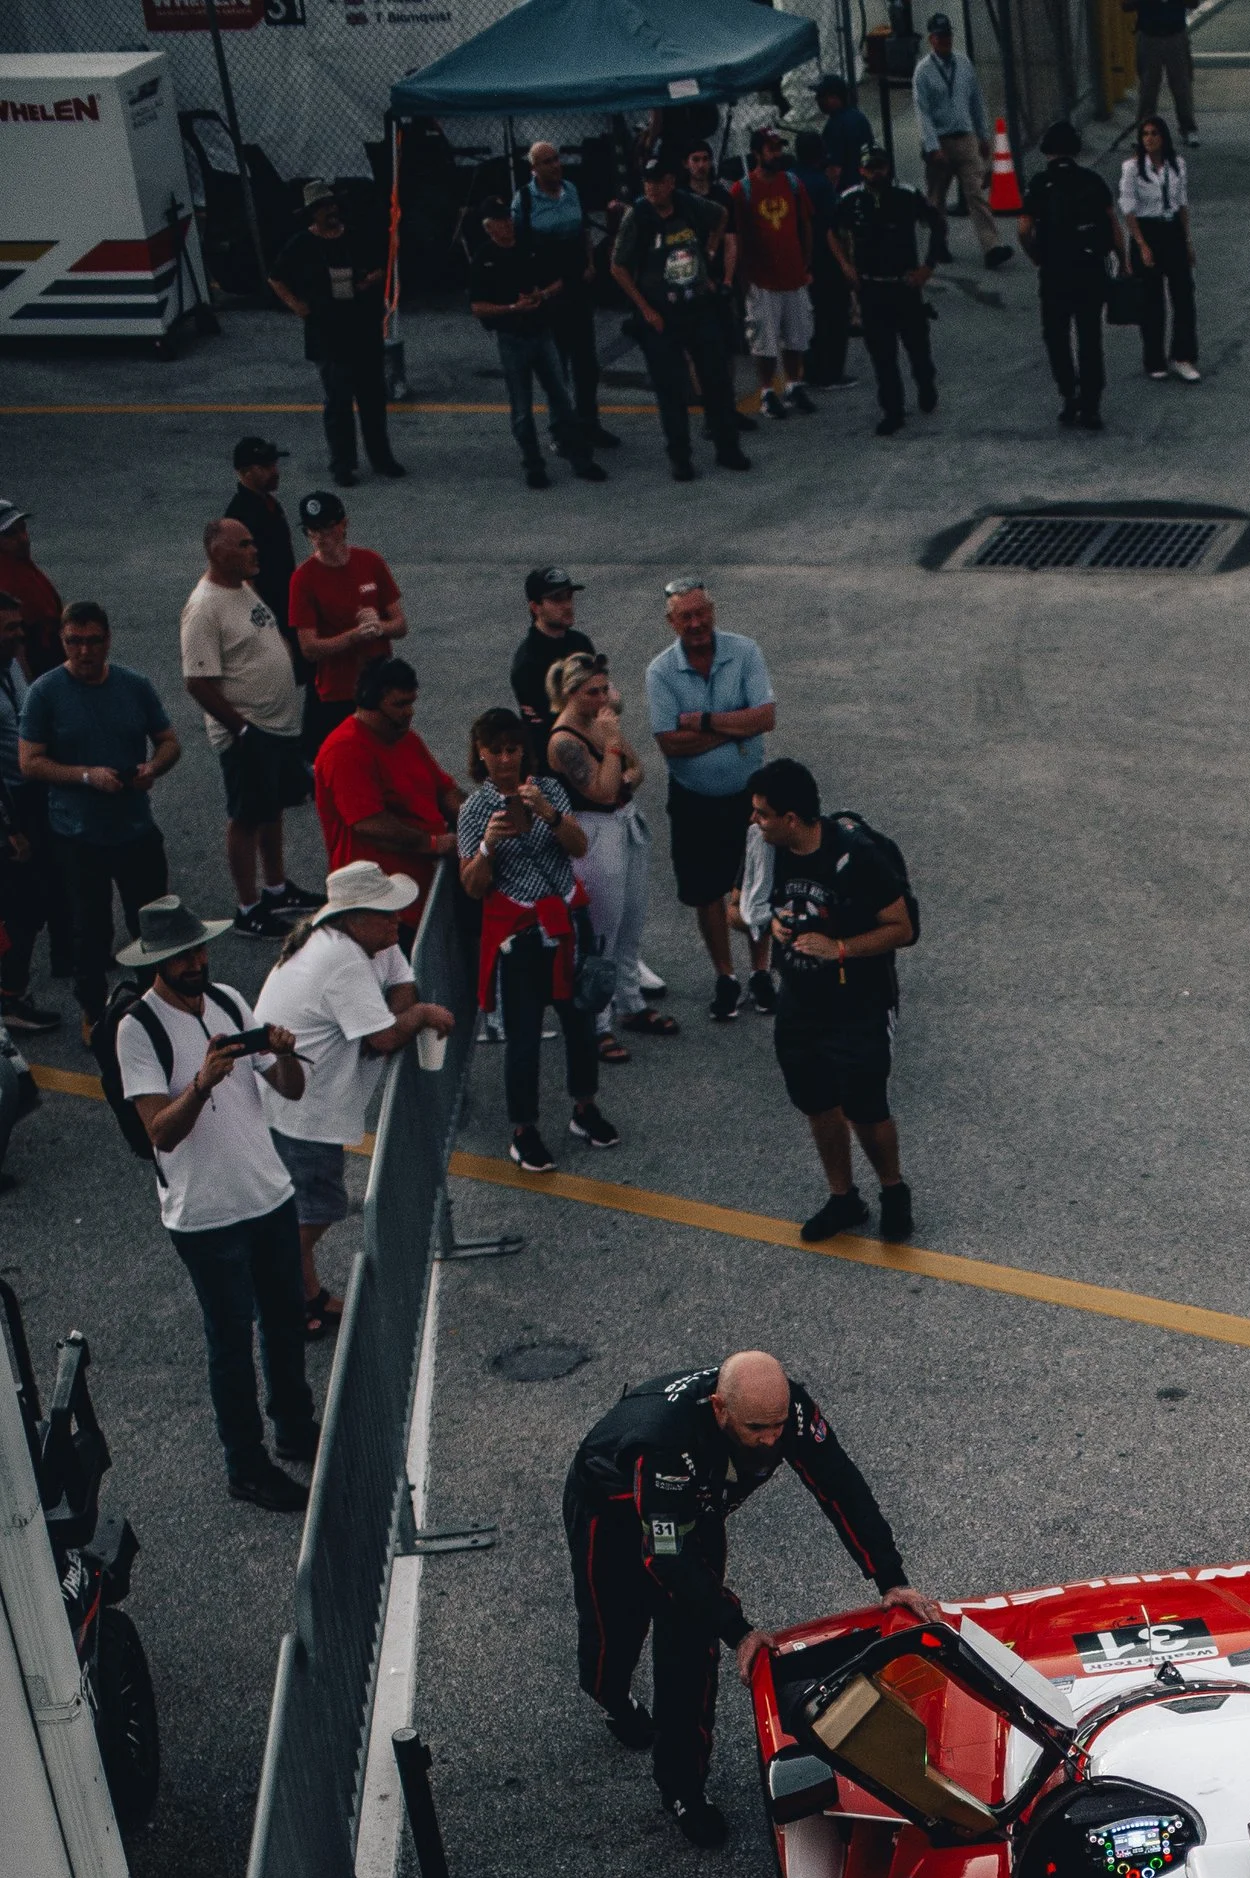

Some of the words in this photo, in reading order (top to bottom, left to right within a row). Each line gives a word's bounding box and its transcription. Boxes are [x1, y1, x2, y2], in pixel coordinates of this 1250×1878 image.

[654, 1523, 673, 1536] 31
[1096, 1623, 1189, 1660] 31
[1089, 1649, 1214, 1671] WeatherTech
